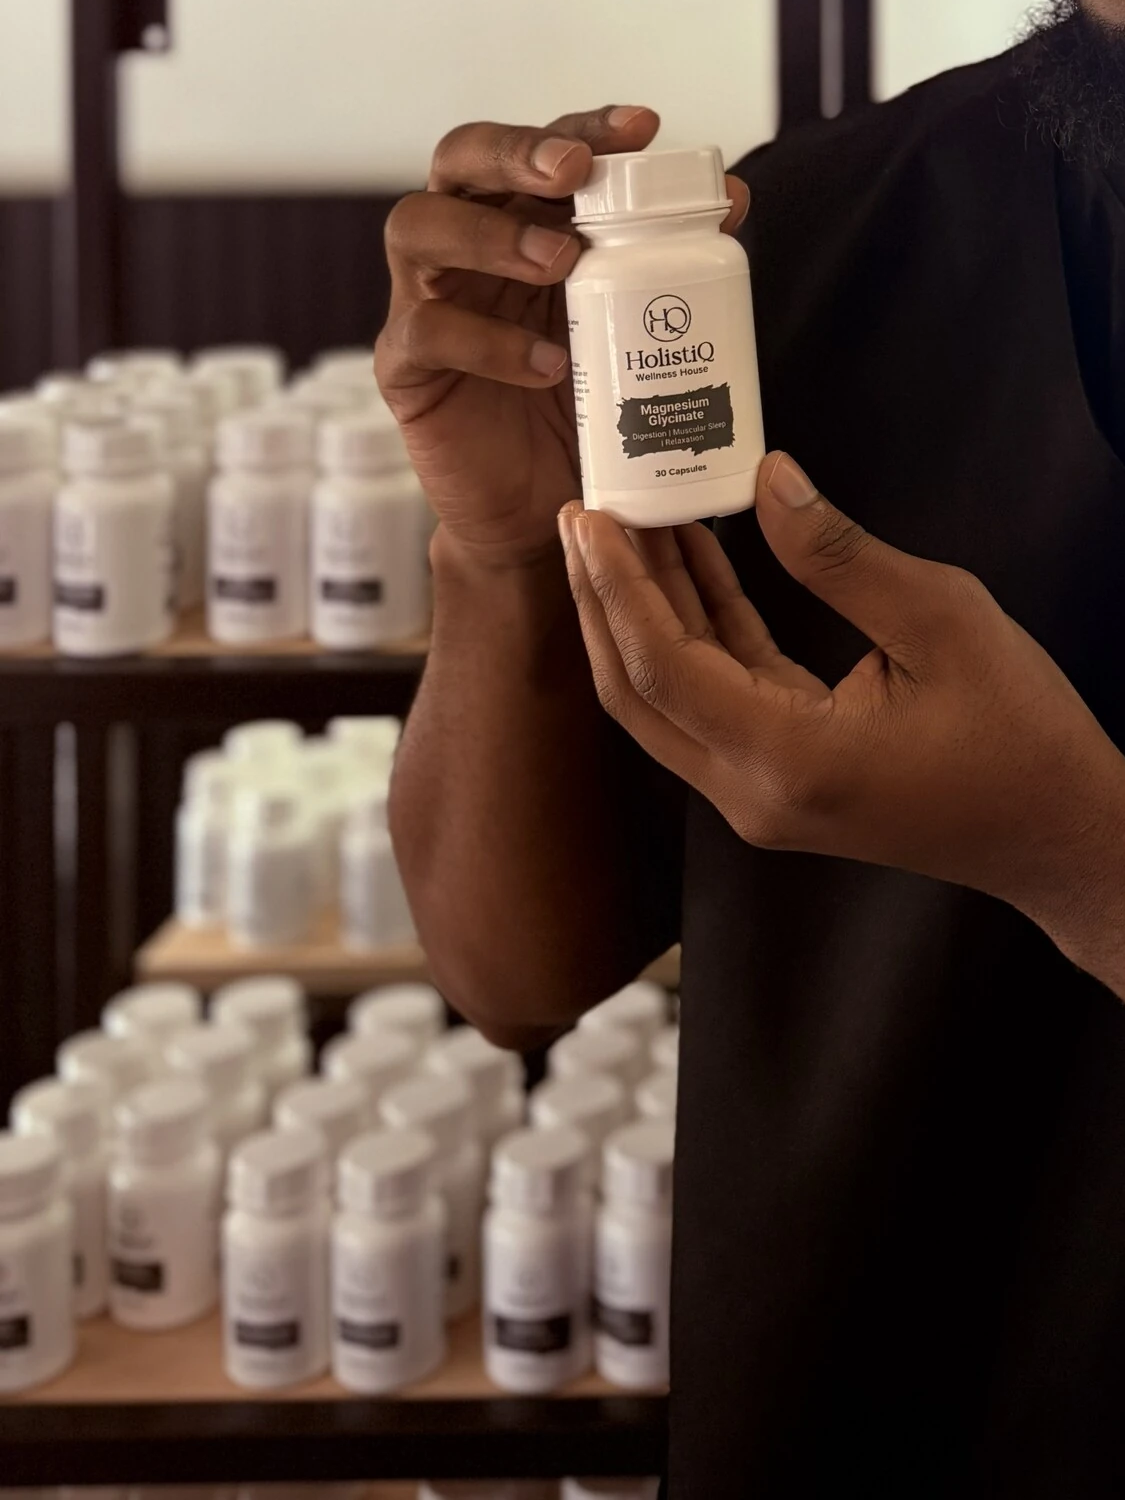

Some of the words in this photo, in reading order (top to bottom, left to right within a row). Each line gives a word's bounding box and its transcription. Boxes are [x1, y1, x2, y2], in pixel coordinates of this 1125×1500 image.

[626, 341, 715, 372] HolistiQ
[635, 370, 678, 382] Wellness
[680, 365, 709, 376] House
[640, 396, 710, 416] Magnesium
[648, 410, 705, 428] Glycinate
[632, 430, 667, 442] Digestion
[672, 423, 706, 436] Muscular
[708, 420, 727, 432] Sleep
[665, 434, 705, 446] Relaxation
[655, 469, 667, 478] 30
[668, 463, 708, 478] Capsules
